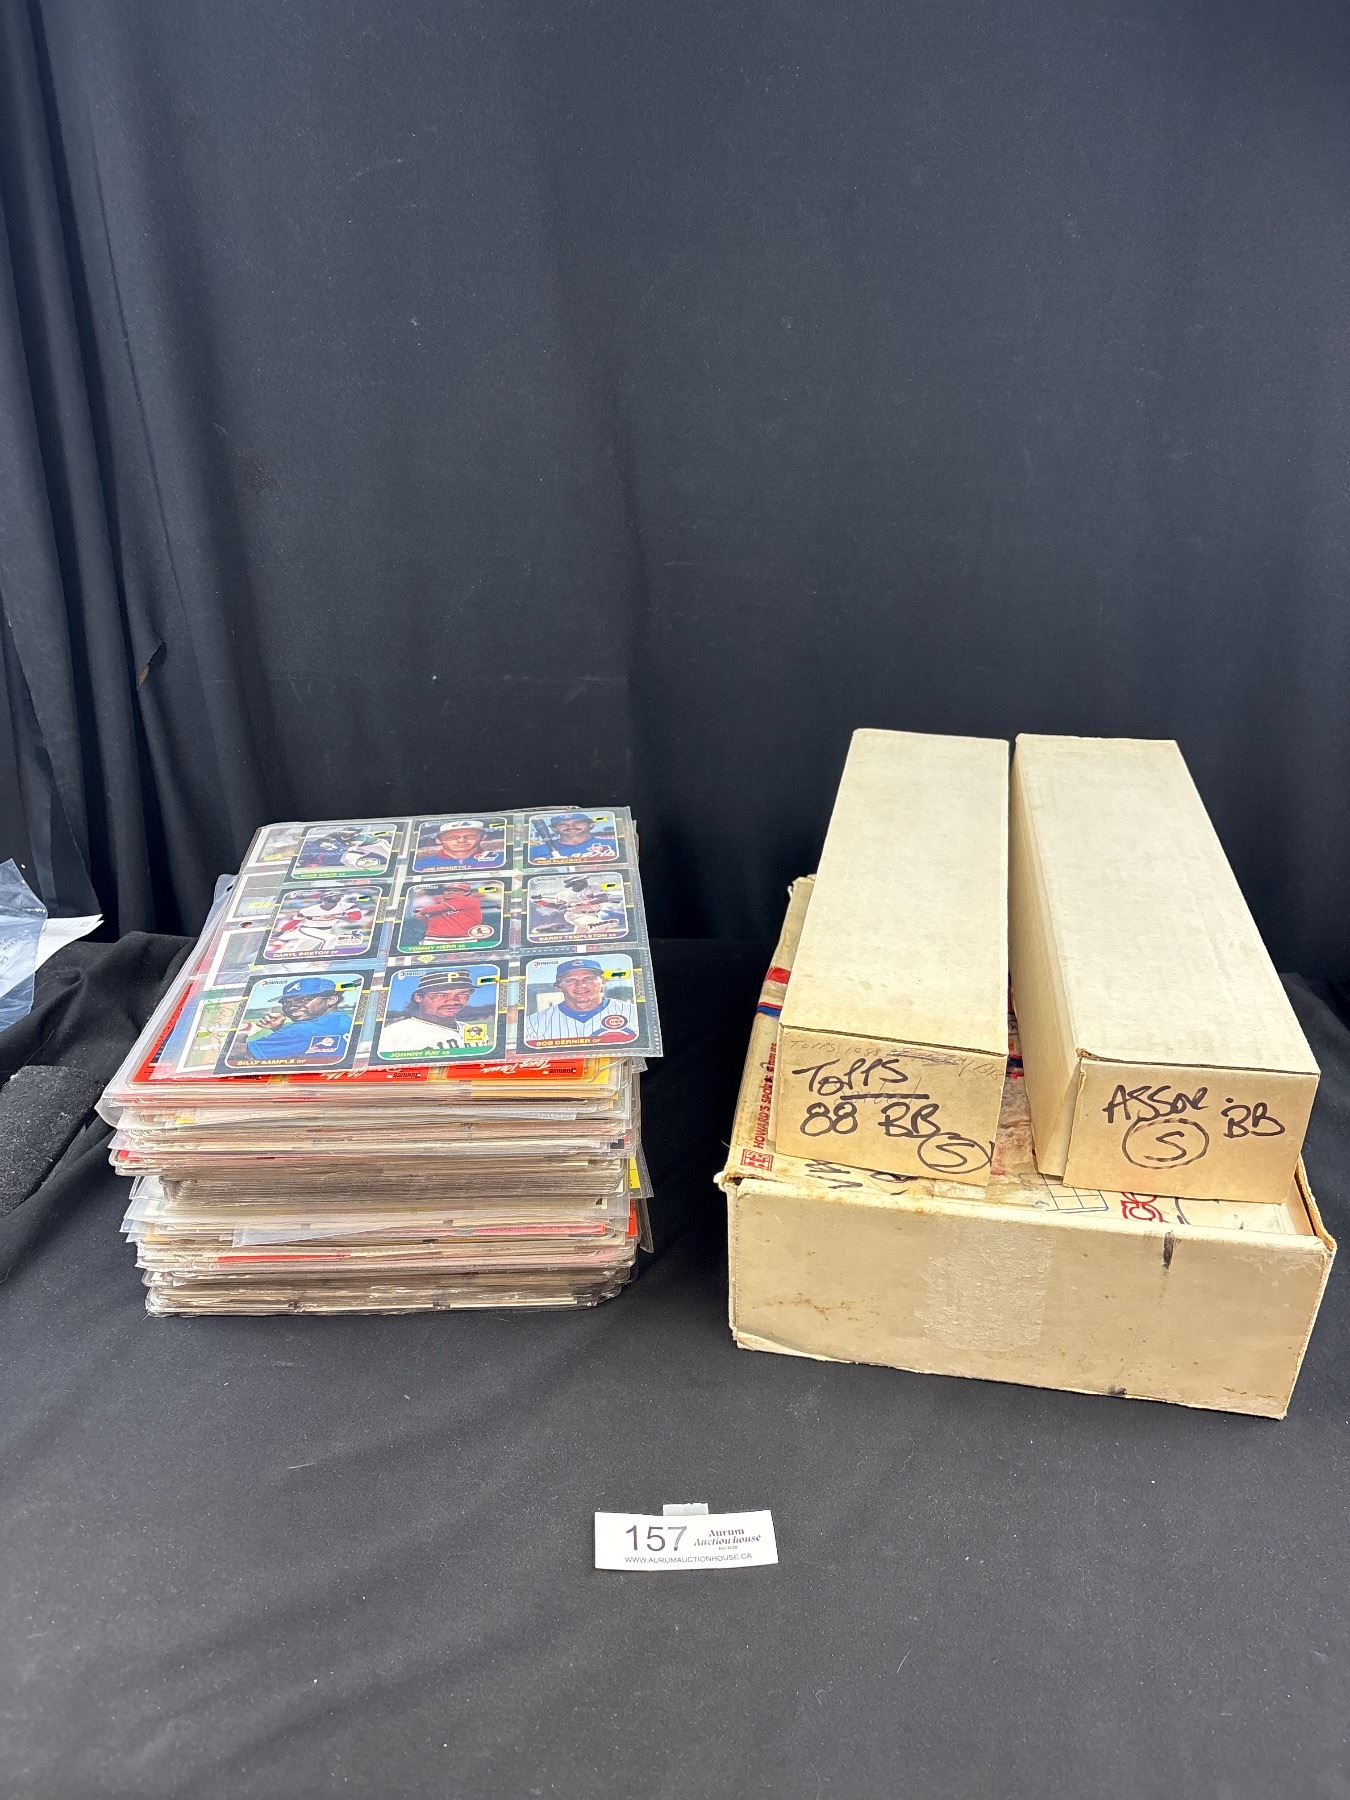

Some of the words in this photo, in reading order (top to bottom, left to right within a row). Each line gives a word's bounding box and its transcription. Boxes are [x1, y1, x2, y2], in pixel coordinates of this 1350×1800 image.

[753, 1105, 769, 1150] HOWARD'S
[799, 1102, 858, 1136] 88
[878, 1101, 942, 1139] BB
[625, 1524, 688, 1552] 157
[708, 1528, 745, 1538] Aurum
[624, 1553, 753, 1563] WWW.AURUMAUCTIONHOUSE.CA
